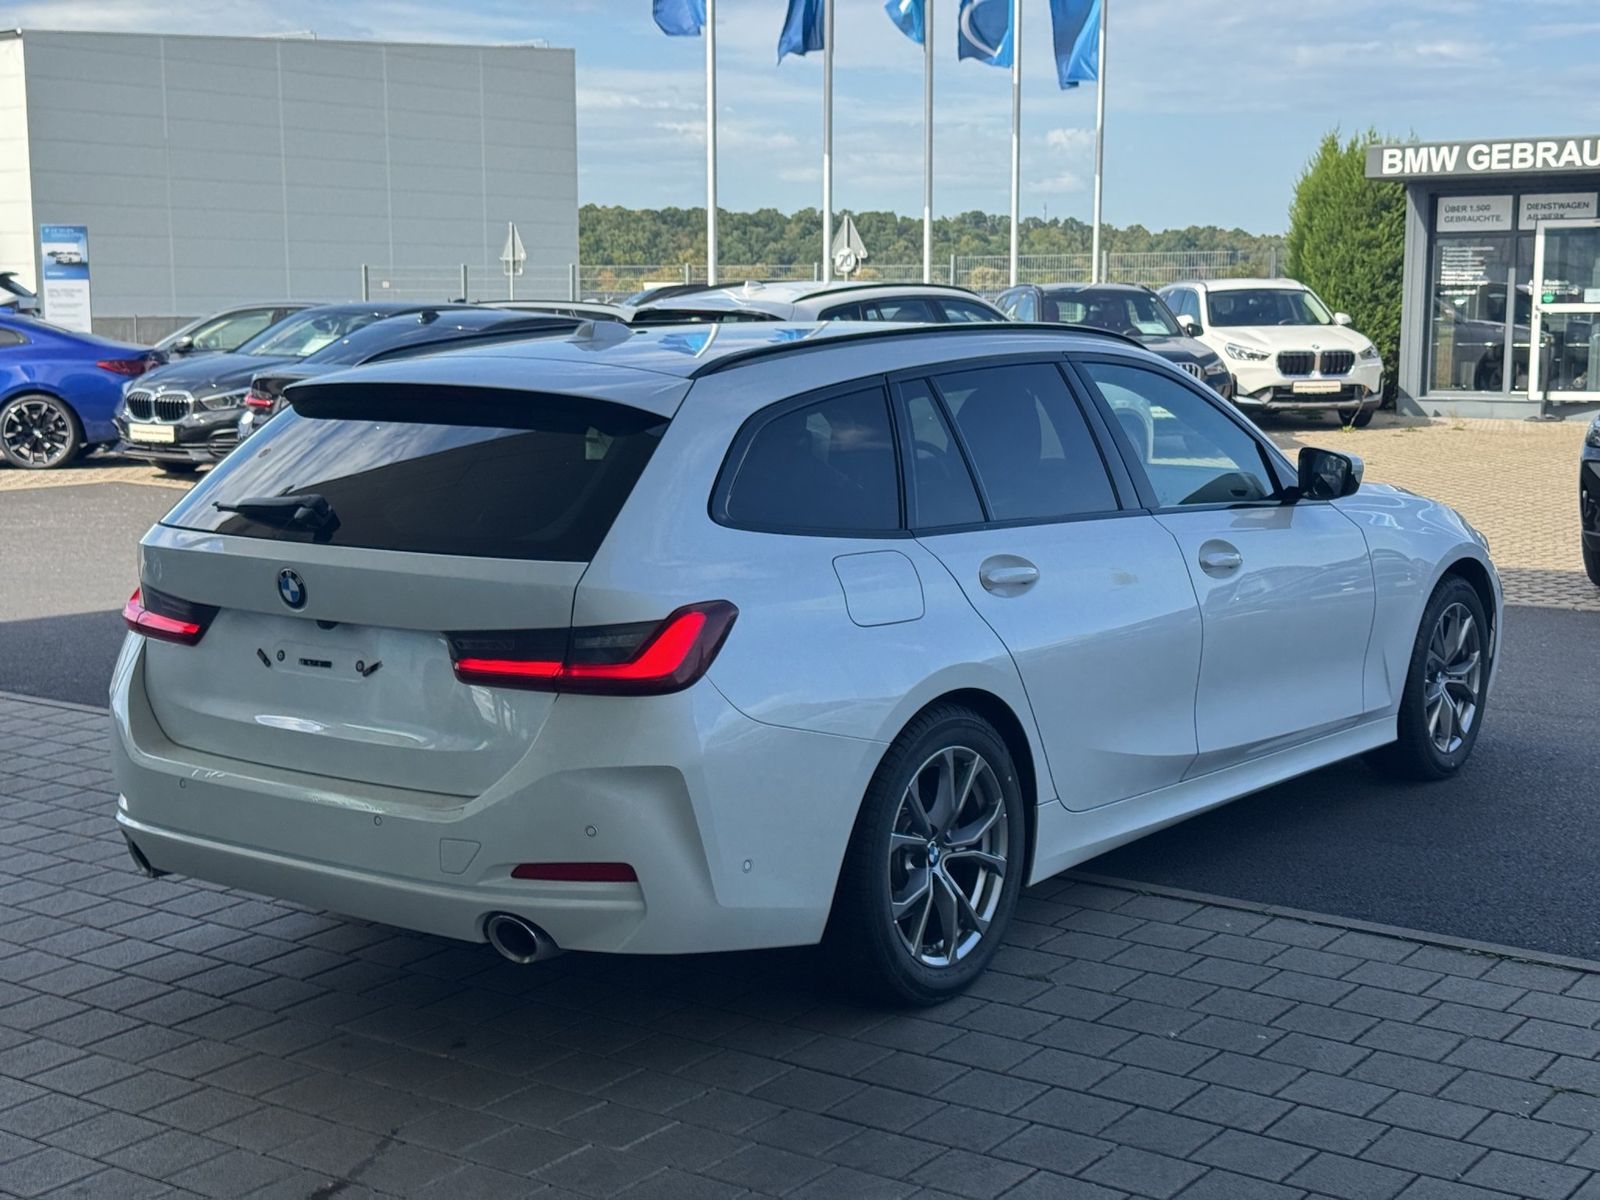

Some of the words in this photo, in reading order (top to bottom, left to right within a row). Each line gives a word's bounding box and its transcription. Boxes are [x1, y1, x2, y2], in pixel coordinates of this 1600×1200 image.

[1382, 145, 1460, 174] BMW
[1467, 139, 1600, 170] GEBRAU
[1444, 203, 1467, 213] ÜBER
[1526, 201, 1590, 210] DIENSTWAGEN
[1444, 214, 1503, 224] GEBRAUCHTE.
